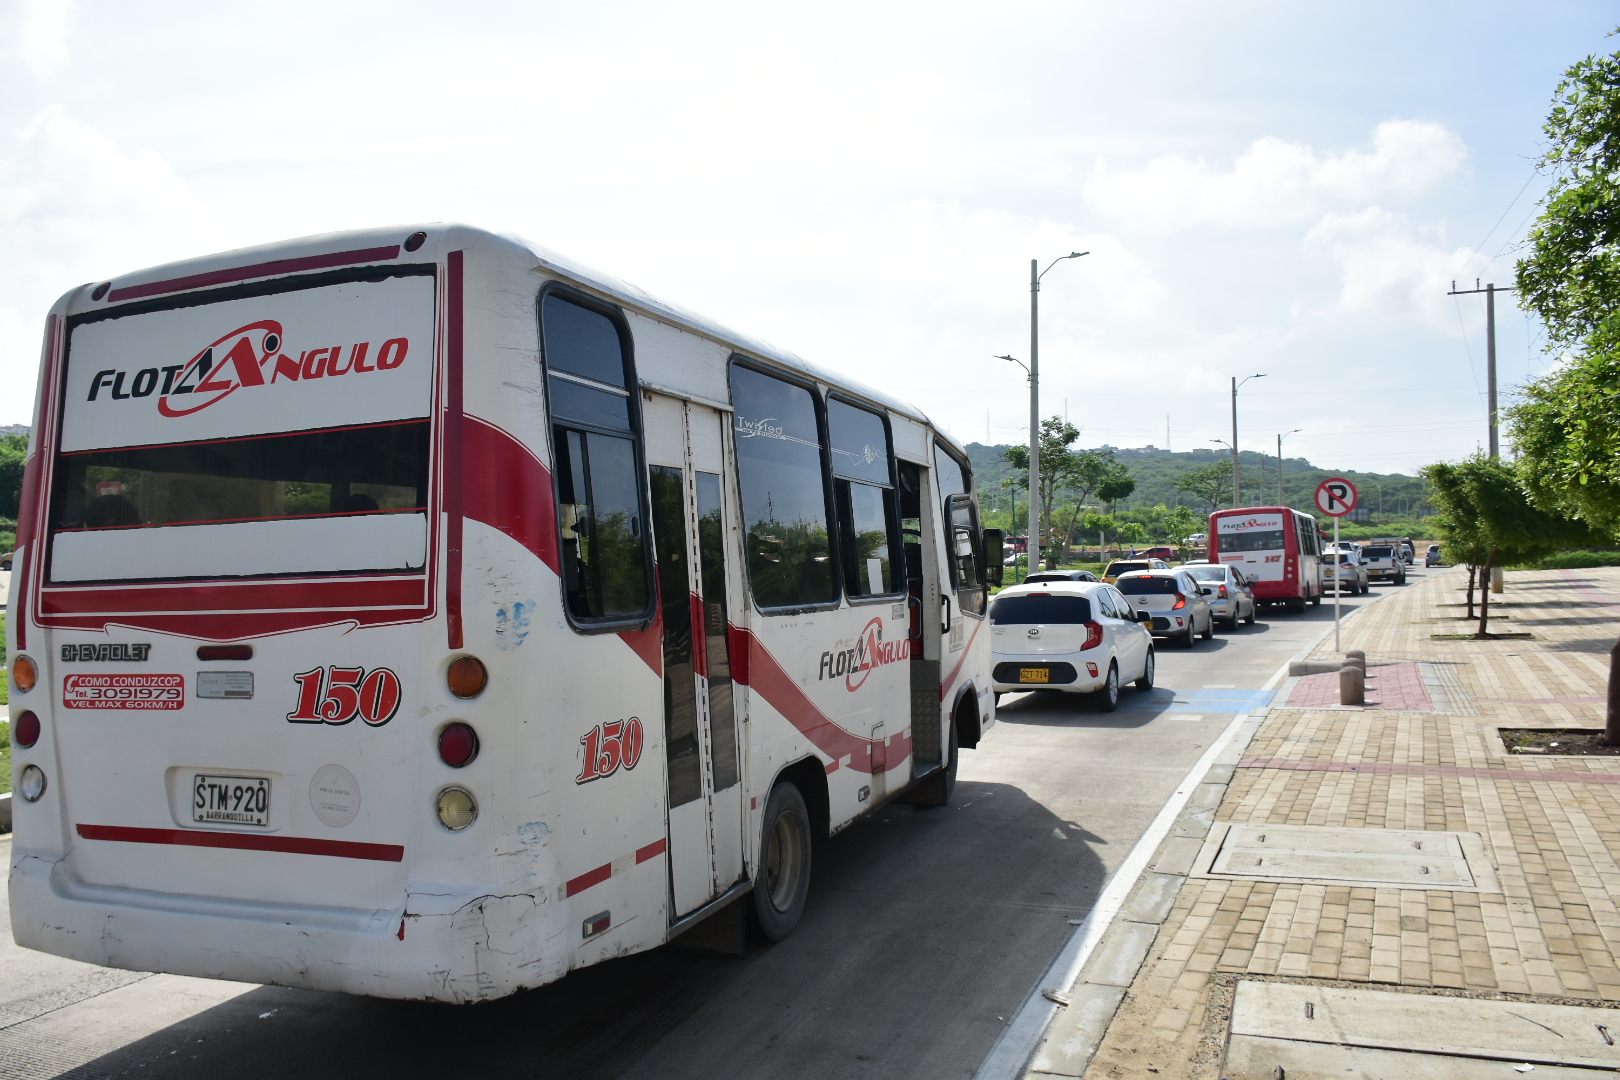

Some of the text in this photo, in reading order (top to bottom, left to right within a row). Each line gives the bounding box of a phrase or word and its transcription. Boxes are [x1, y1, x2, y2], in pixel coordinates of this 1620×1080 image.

[87, 336, 409, 402] FLOTA ANGULO
[737, 416, 783, 436] Twisted
[1328, 485, 1347, 510] P
[61, 643, 151, 662] CHEVROLET
[819, 635, 864, 681] FLOTA
[79, 677, 181, 686] COMO CONDUZCO?
[75, 688, 181, 699] Tel. 3091979
[286, 665, 402, 727] 150
[70, 700, 177, 709] VEL.MAX 60KM/H
[575, 716, 644, 786] 150
[206, 811, 254, 822] BARRANQUILLA
